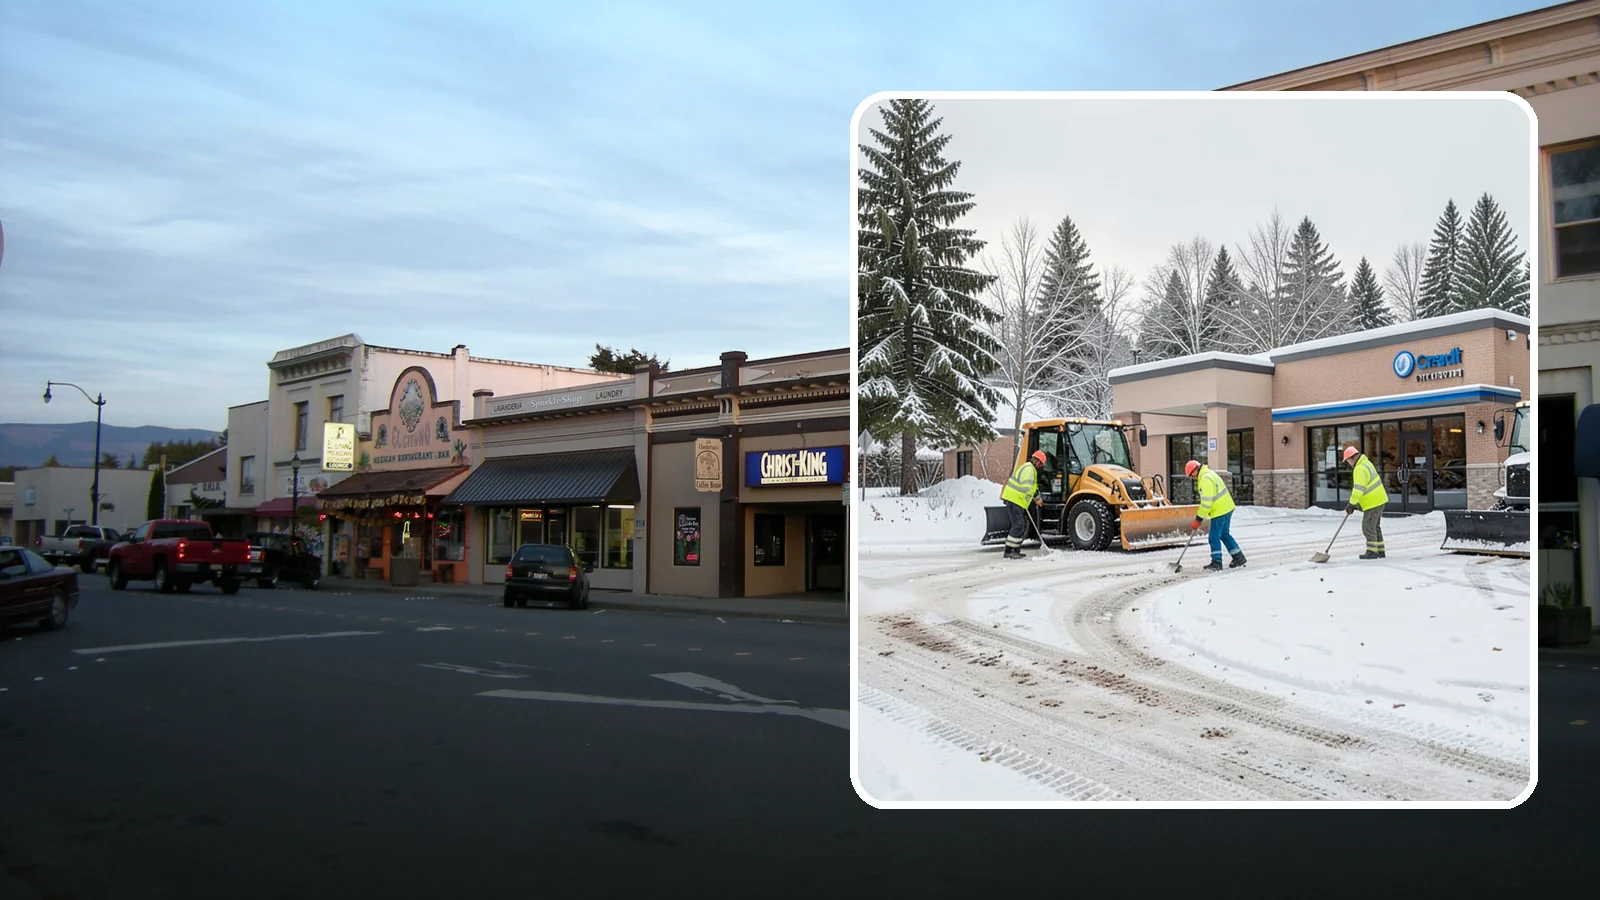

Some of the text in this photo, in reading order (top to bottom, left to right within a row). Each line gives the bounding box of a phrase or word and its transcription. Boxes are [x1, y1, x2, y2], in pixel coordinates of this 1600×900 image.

[595, 388, 624, 400] LAUNDRY
[493, 402, 523, 413] LAVANDERIA
[530, 394, 582, 410] Sparkle Shop
[373, 454, 396, 464] MEXICAN
[397, 451, 433, 462] RESTAURANT
[437, 450, 450, 459] BAR
[760, 449, 827, 478] CHRIST KING
